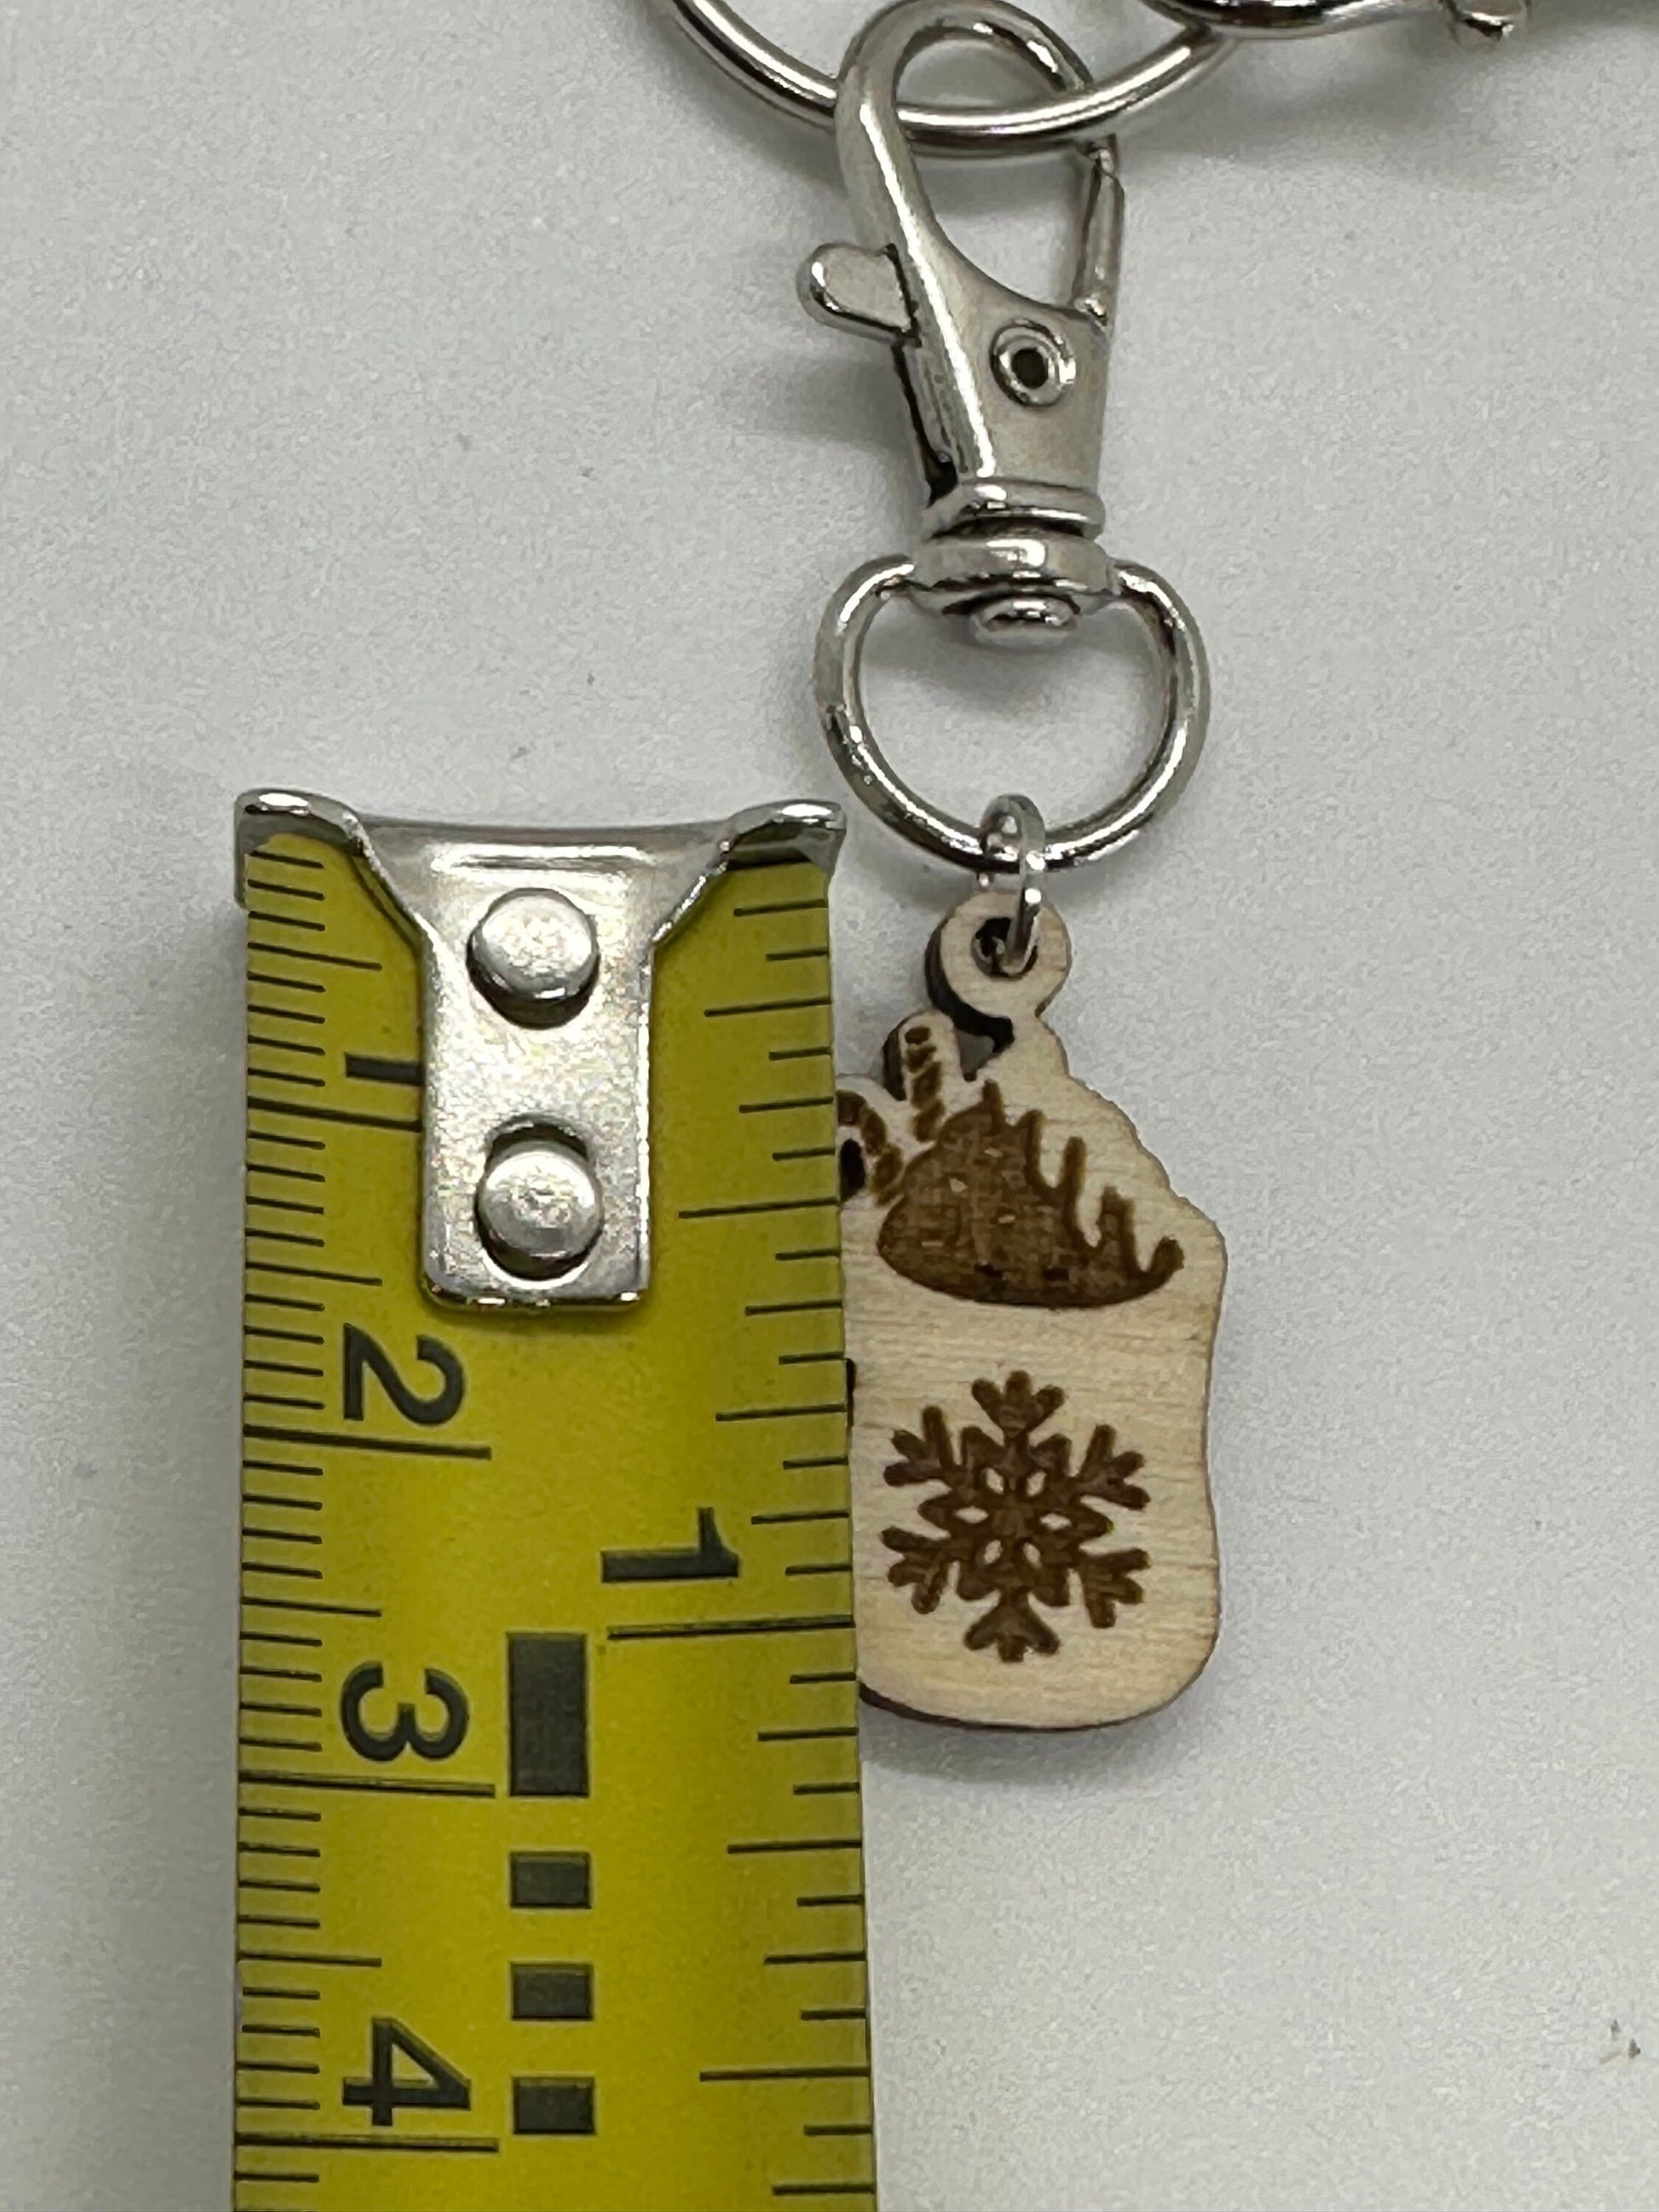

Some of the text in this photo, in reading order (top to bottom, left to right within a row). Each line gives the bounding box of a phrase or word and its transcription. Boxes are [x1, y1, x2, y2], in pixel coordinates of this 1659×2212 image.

[343, 1322, 465, 1427] 2
[600, 1506, 739, 1584] 1
[340, 1660, 471, 1763] 3
[342, 2016, 471, 2127] 4
